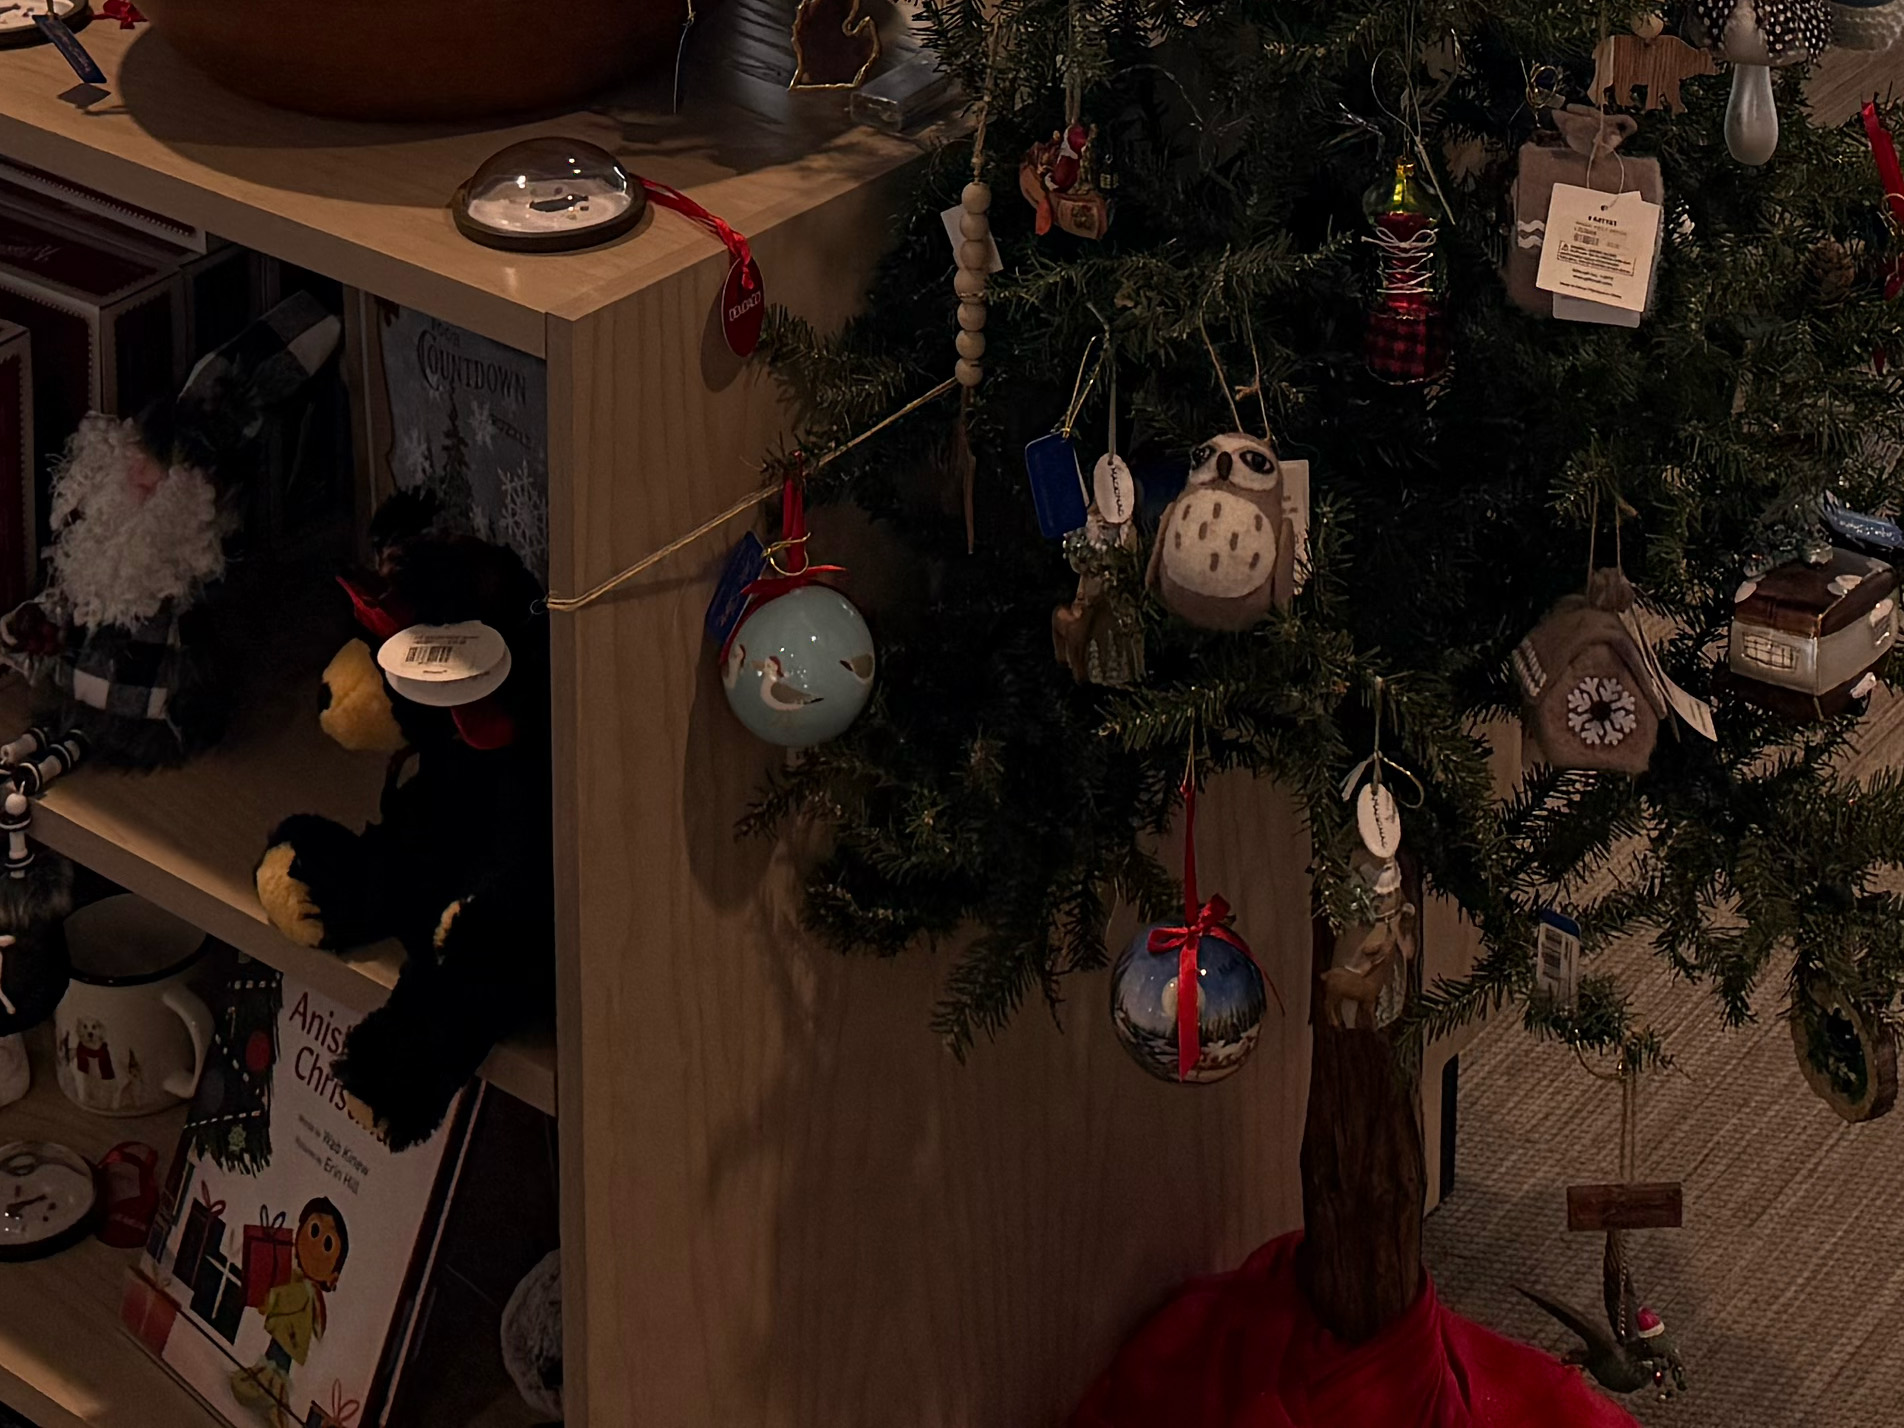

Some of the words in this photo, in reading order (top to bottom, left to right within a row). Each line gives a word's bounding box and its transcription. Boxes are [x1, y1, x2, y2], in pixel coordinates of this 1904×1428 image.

[417, 329, 527, 405] COUNTDOWN
[289, 991, 346, 1055] Anis
[323, 1130, 342, 1156] Wab
[323, 1156, 343, 1183] Erin
[343, 1172, 361, 1195] Hill
